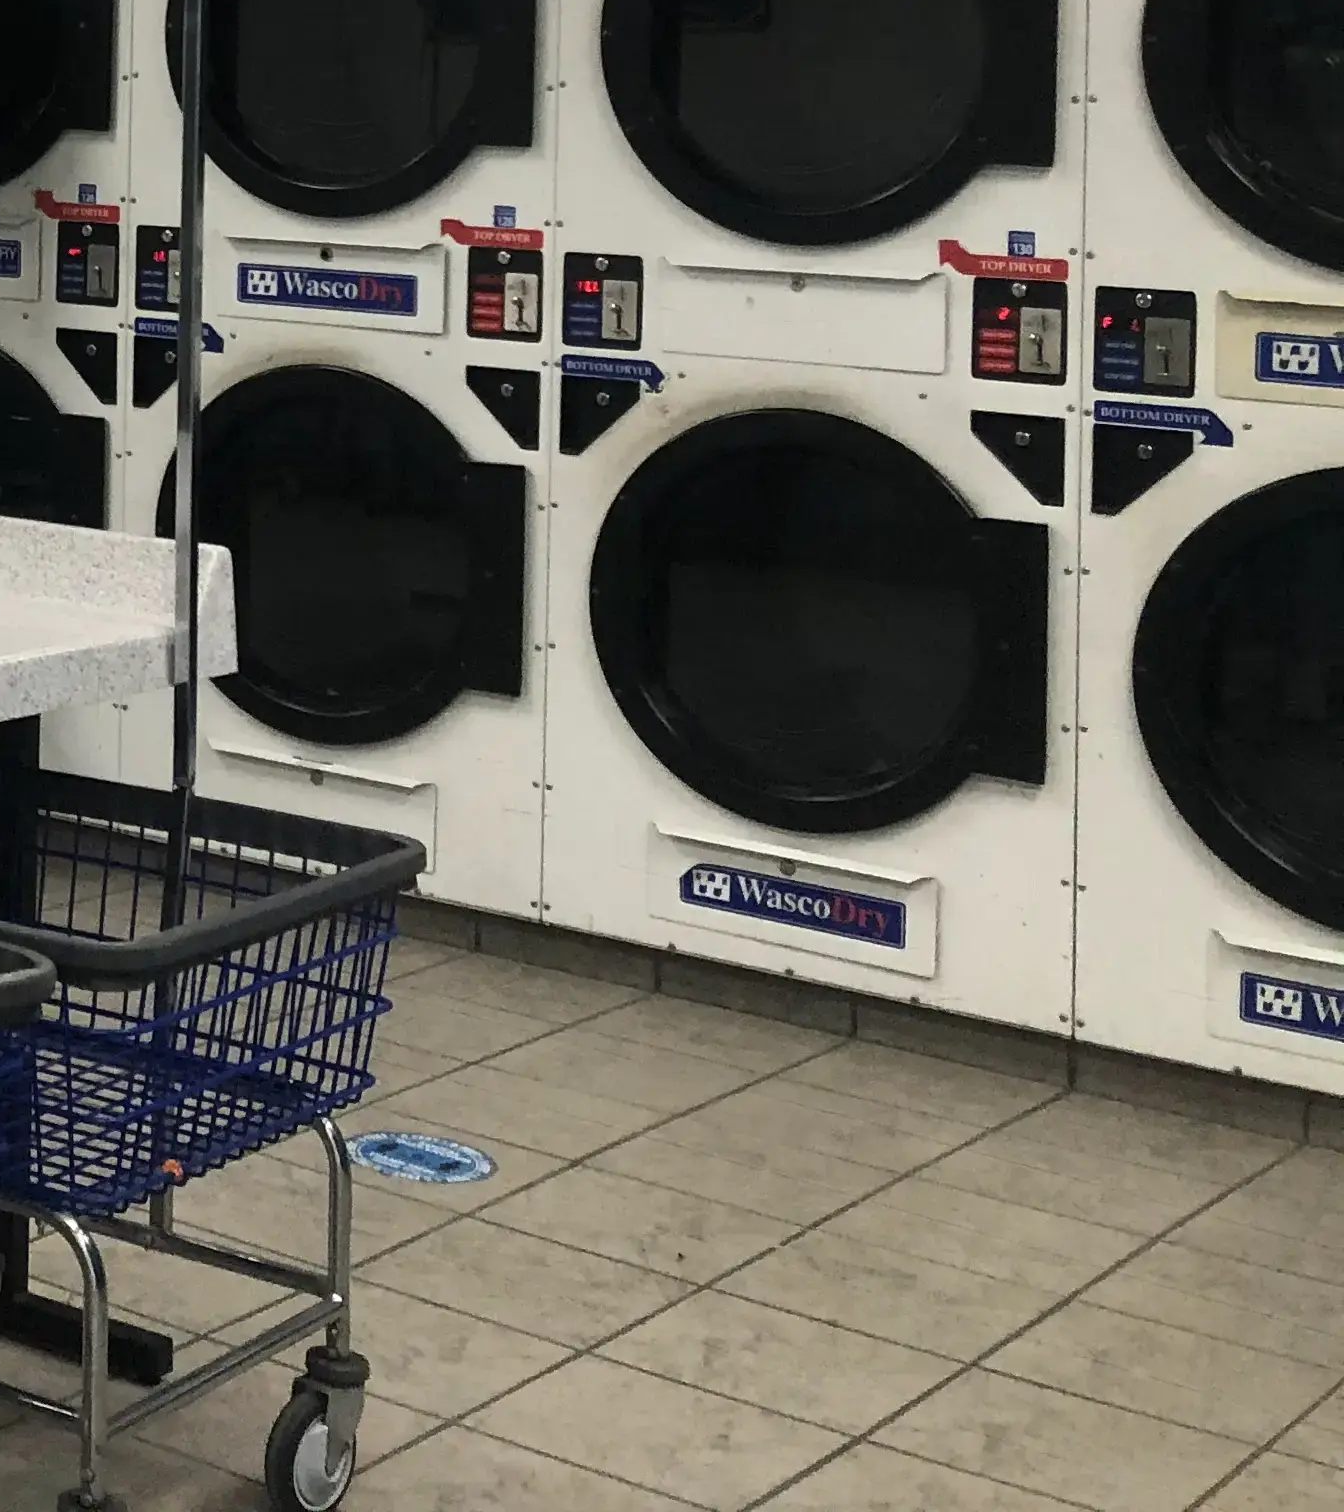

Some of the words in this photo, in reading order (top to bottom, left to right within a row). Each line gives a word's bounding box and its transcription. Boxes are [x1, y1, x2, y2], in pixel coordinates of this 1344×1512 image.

[474, 231, 495, 241] TOP
[497, 232, 531, 243] DRYER
[1011, 242, 1033, 255] 130
[979, 259, 1010, 271] TOP
[1011, 262, 1052, 275] DRYER
[283, 271, 403, 310] WascoDry
[565, 359, 613, 374] BOTTOM
[614, 363, 653, 377] DRYER
[1100, 406, 1160, 422] BOTTOM
[1163, 411, 1212, 427] DRYER
[736, 874, 890, 938] WascoDry
